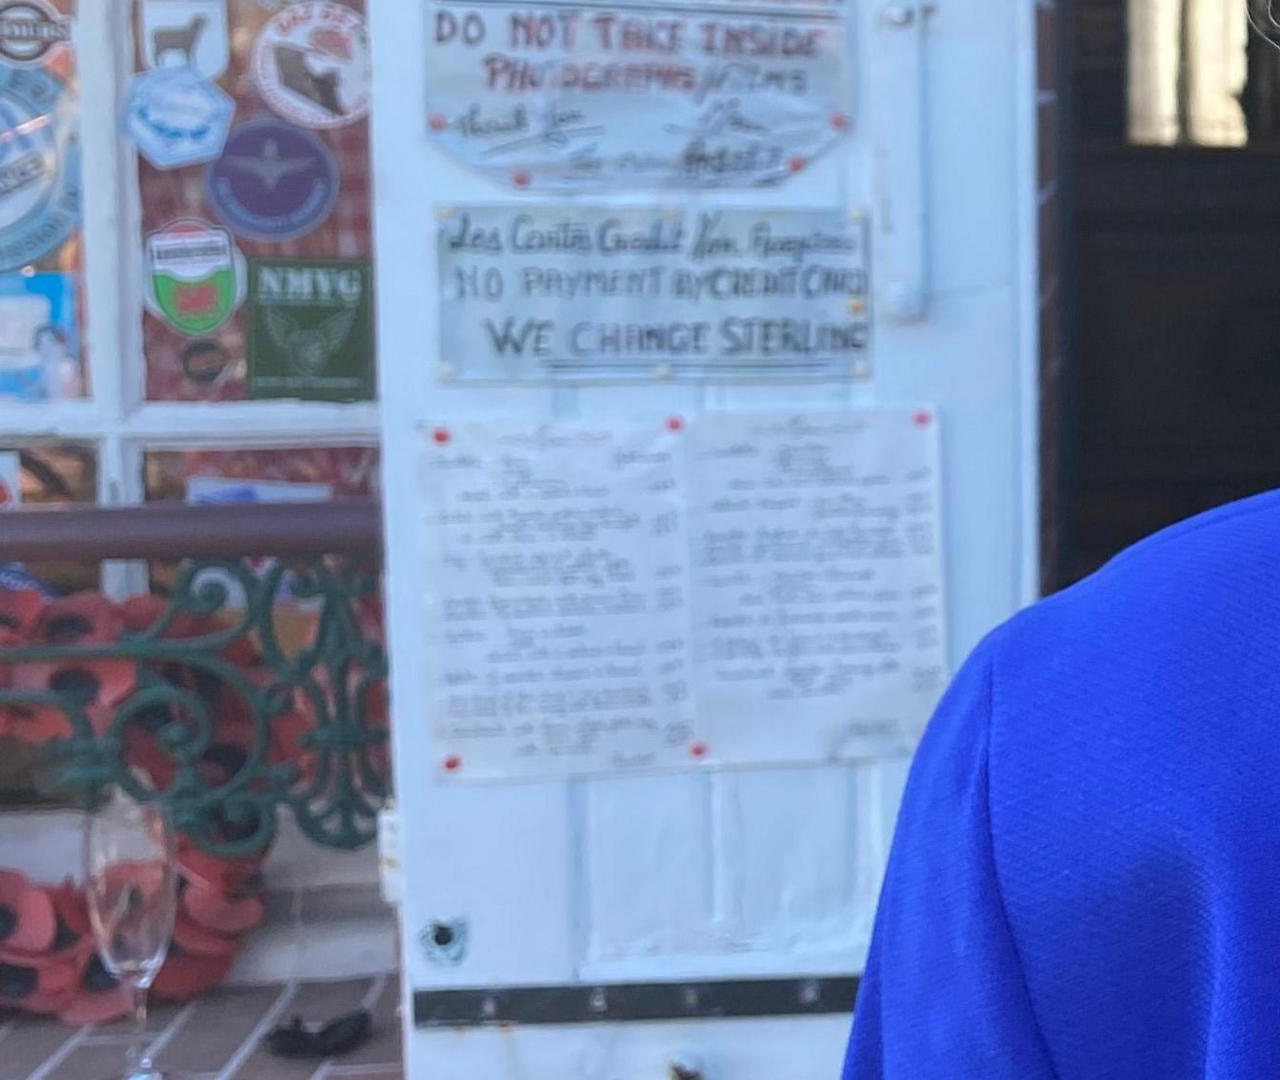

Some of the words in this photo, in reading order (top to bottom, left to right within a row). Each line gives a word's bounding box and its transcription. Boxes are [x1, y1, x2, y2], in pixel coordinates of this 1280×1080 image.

[433, 10, 488, 46] DO
[510, 11, 580, 50] NOT
[592, 11, 686, 54] TAKE
[699, 21, 825, 58] INSIDE
[449, 213, 503, 255] Les
[454, 265, 505, 302] NO
[523, 264, 666, 299] PAYMENT
[484, 316, 554, 357] WE
[571, 320, 712, 354] CHANGE
[719, 317, 869, 354] STERLING
